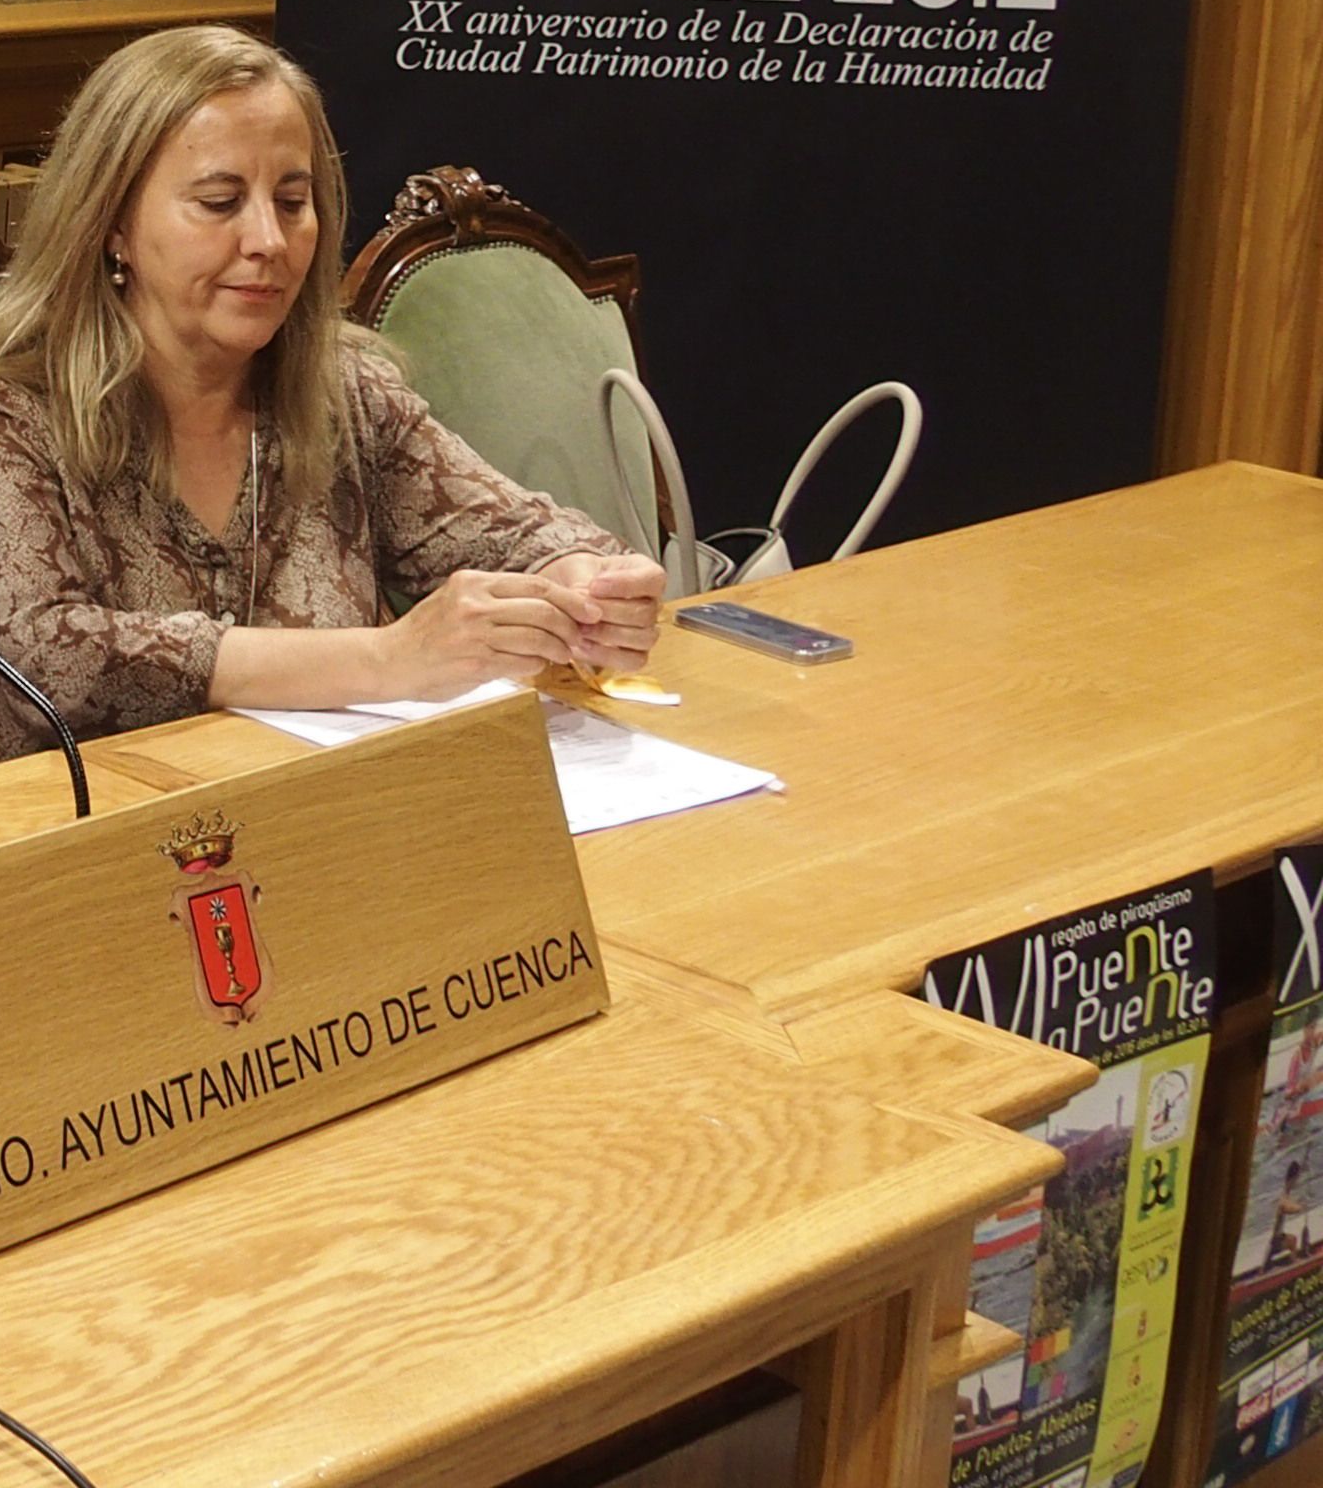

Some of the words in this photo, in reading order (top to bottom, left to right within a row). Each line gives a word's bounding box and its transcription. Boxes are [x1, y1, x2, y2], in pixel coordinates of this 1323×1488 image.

[399, 0, 462, 32] XX
[466, 6, 667, 40] aniversario
[679, 9, 721, 41] de
[731, 10, 765, 42] la
[775, 12, 998, 51] Declaración
[1010, 20, 1053, 52] de
[397, 38, 526, 73] Ciudad
[533, 43, 728, 79] Patrimonio
[740, 48, 782, 81] de
[793, 50, 826, 82] la
[836, 52, 1052, 90] Humanidad
[1051, 917, 1096, 948] regata
[1099, 910, 1118, 932] de
[1121, 888, 1193, 930] piragüismo
[1052, 919, 1193, 1009] Puente
[1072, 970, 1214, 1053] Puente
[62, 1011, 373, 1170] AYUNTAMIENTO
[381, 987, 437, 1045] DE
[444, 931, 593, 1019] CUENCA
[975, 1429, 1034, 1472] Puertas
[1036, 1399, 1098, 1441] Abiertas
